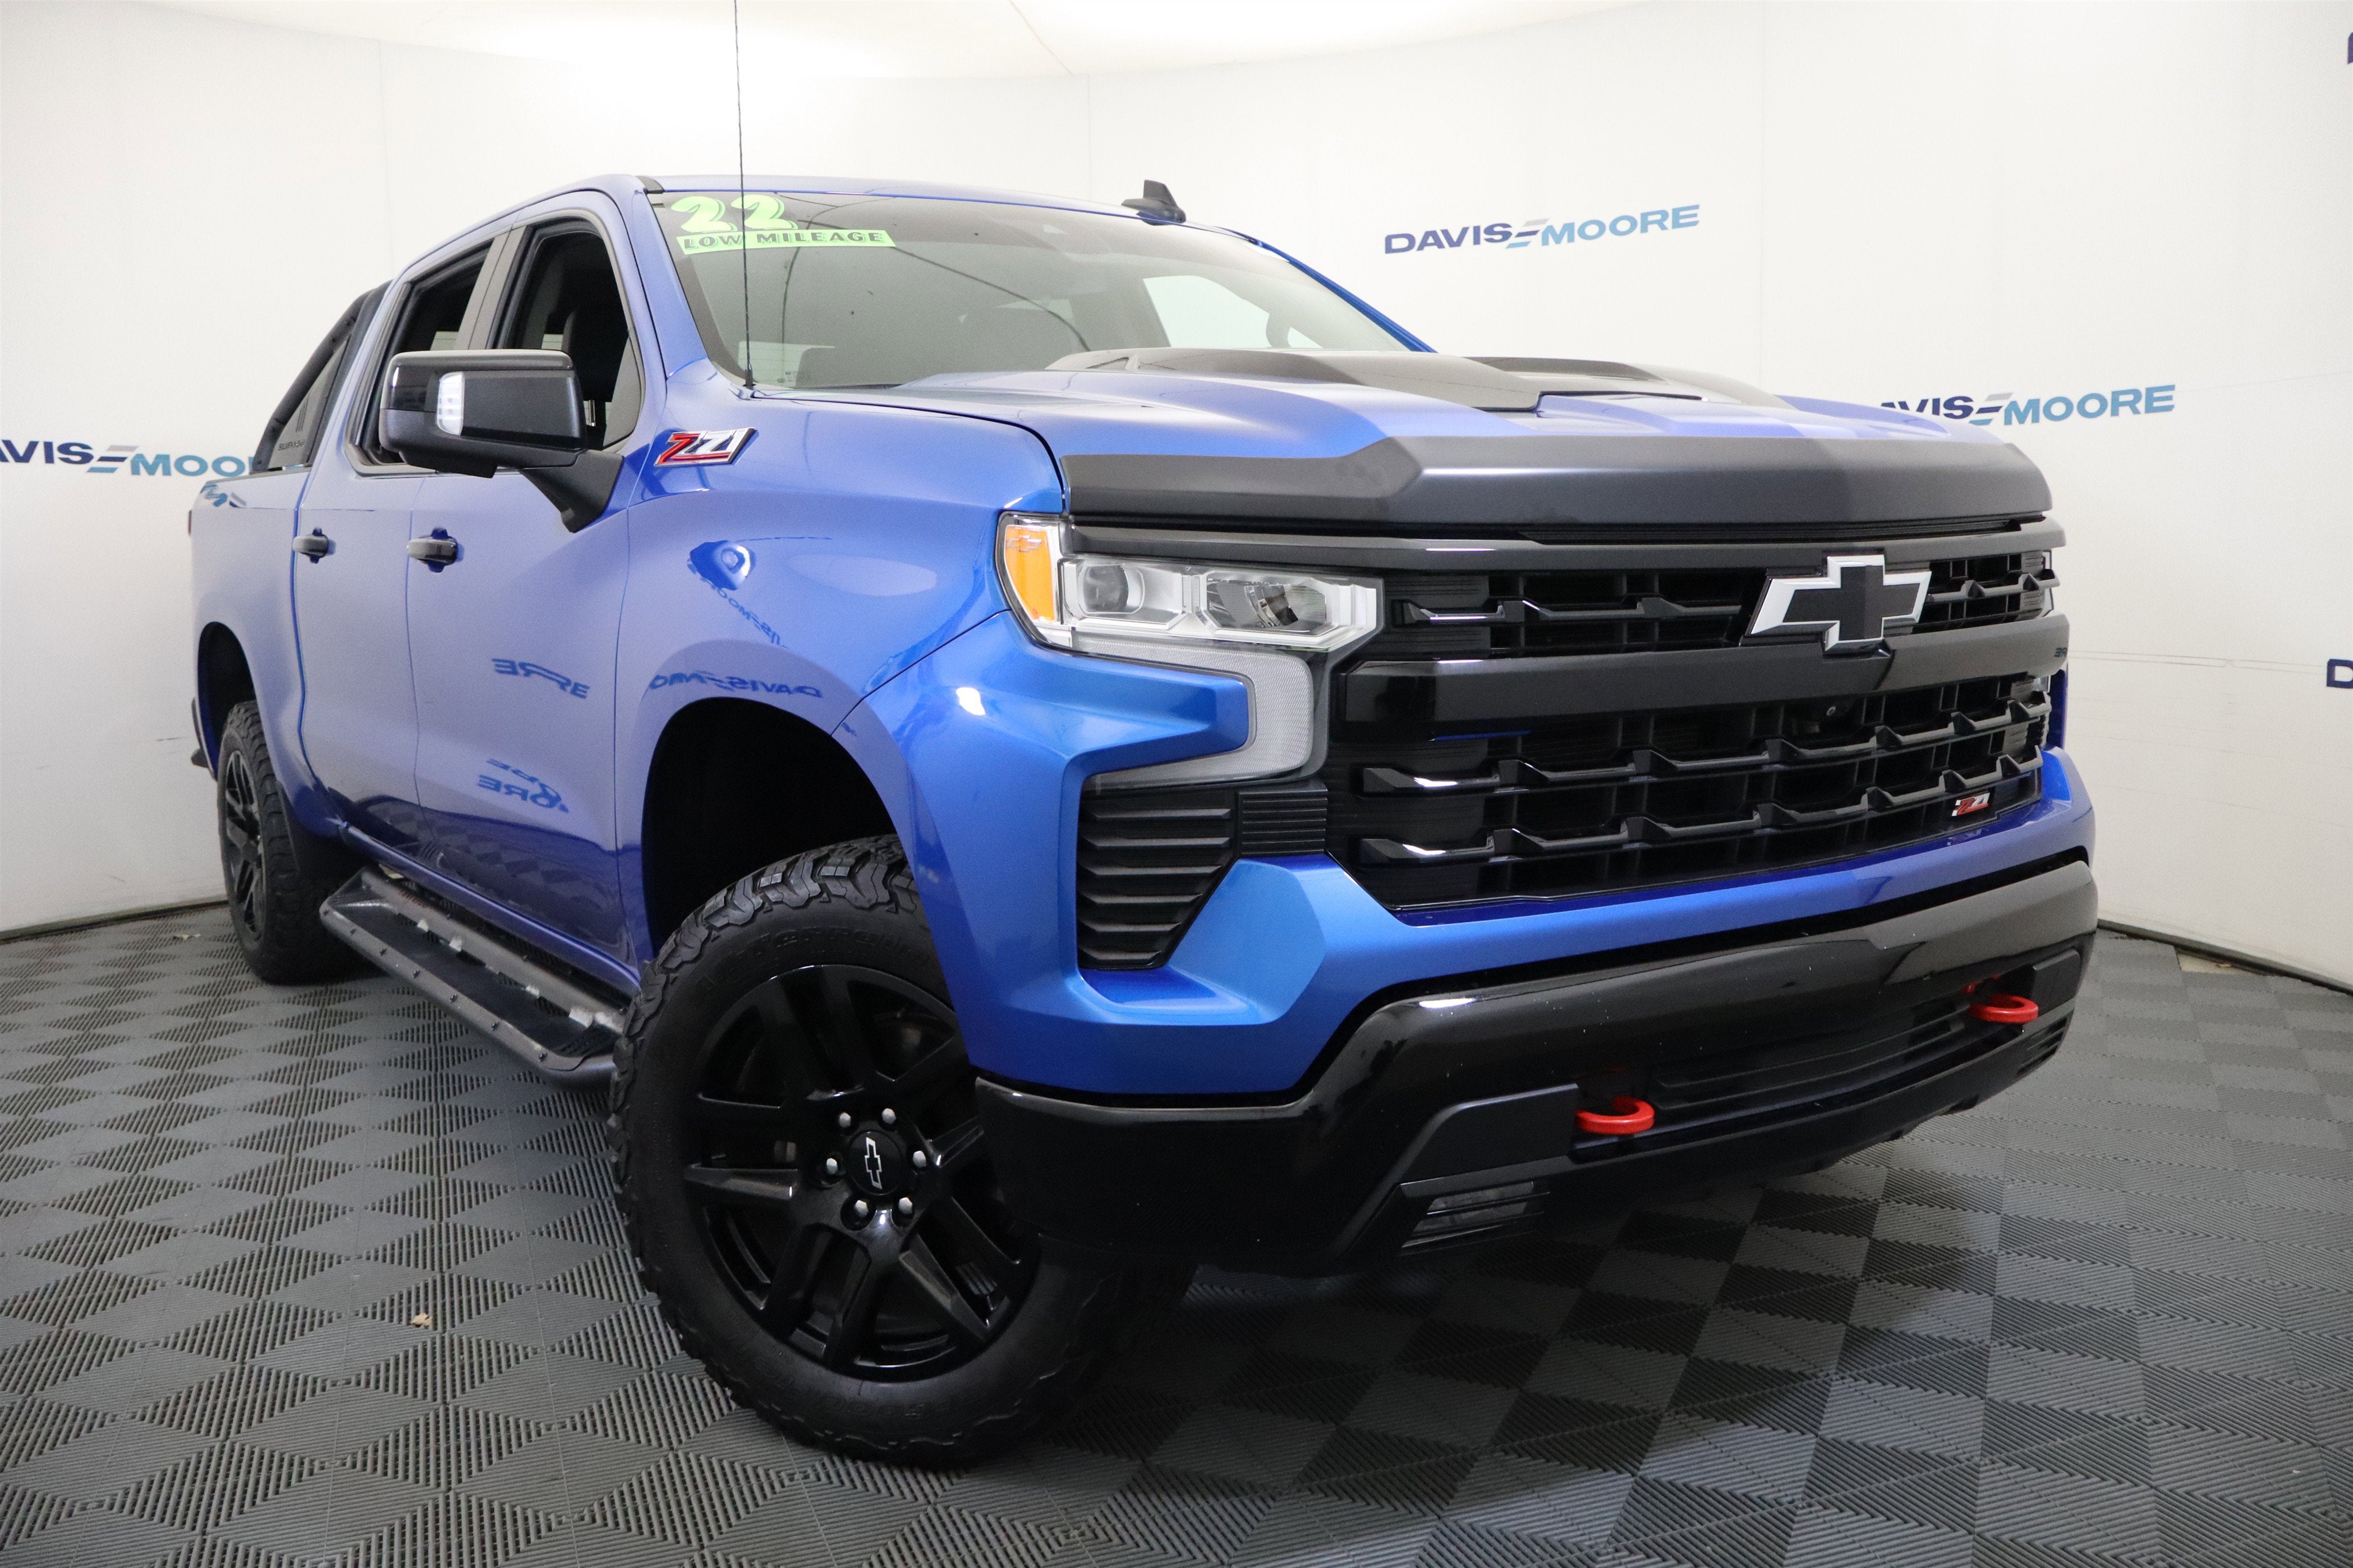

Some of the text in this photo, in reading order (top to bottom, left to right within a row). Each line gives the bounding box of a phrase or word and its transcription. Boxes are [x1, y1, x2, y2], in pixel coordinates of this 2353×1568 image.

[670, 194, 798, 233] 22
[1384, 204, 1700, 254] DAVIS MOORE
[684, 231, 882, 250] LOW MILEAGE
[1880, 384, 2175, 426] VIS MOORE
[130, 453, 255, 477] MOO
